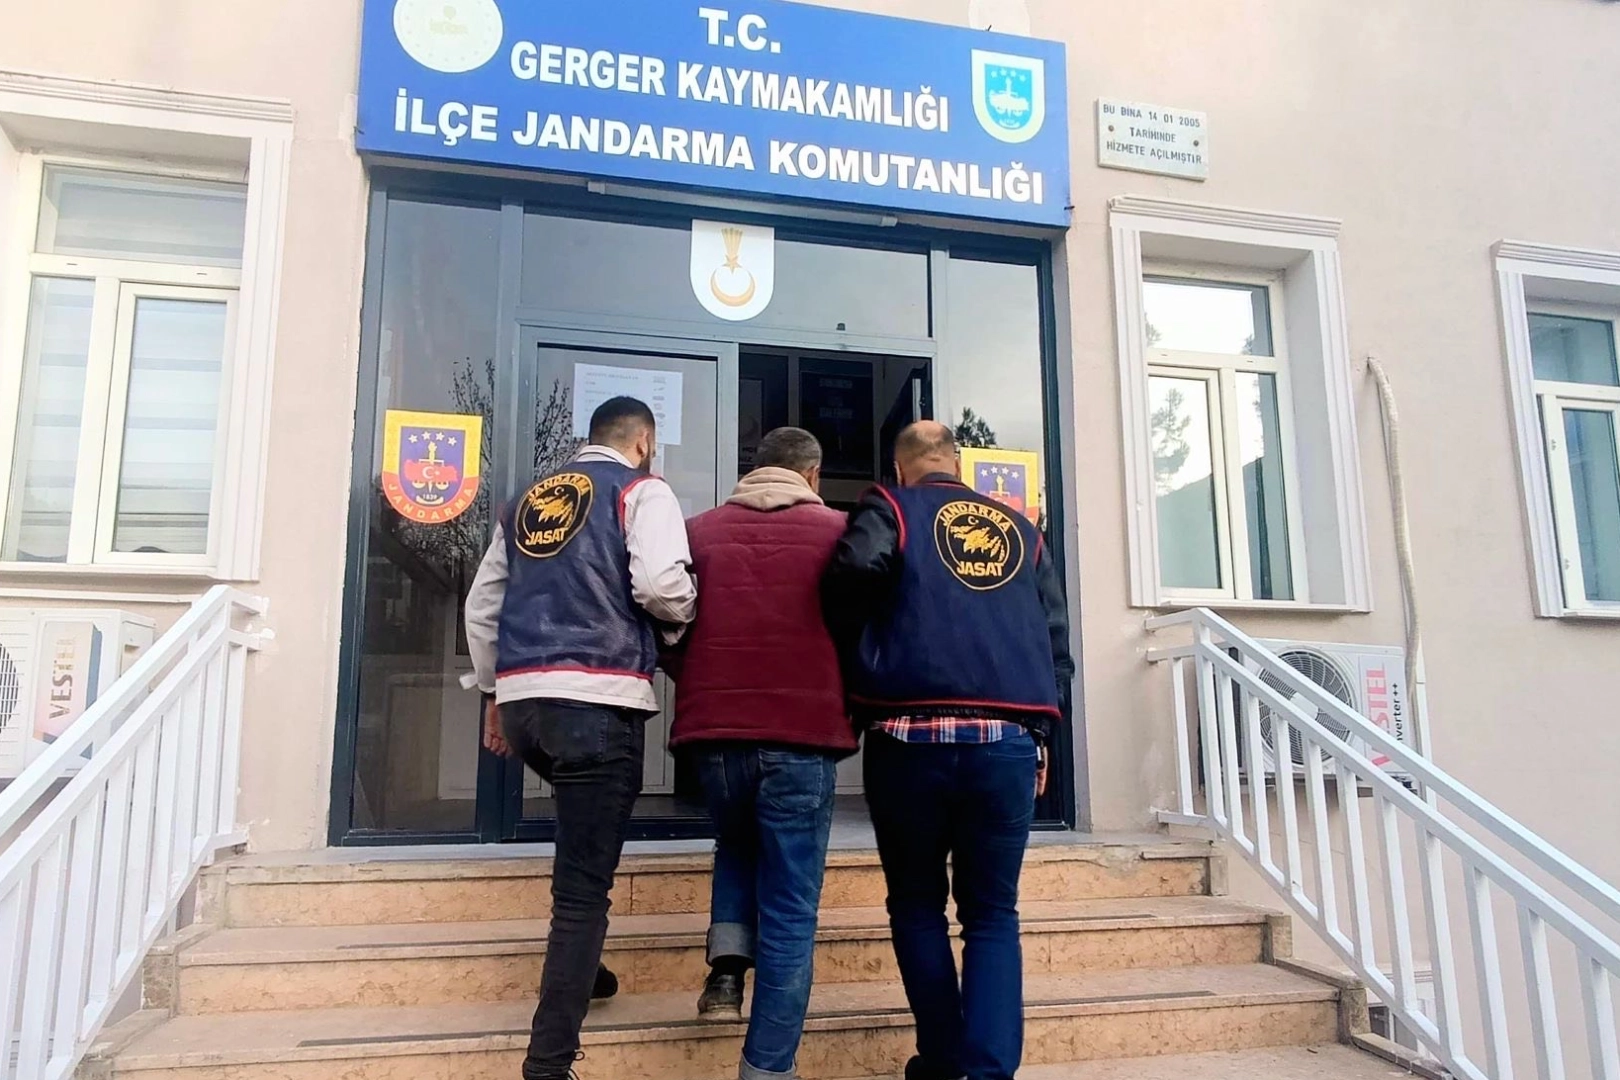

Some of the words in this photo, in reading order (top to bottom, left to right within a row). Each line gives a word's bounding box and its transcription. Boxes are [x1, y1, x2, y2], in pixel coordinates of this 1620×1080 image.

[699, 7, 782, 53] T.C.
[510, 41, 666, 96] GERGER
[677, 62, 949, 133] KAYMAKAMLIĞI
[1103, 104, 1115, 114] BU
[1121, 106, 1142, 118] BİNA
[1149, 111, 1157, 121] 14
[1163, 114, 1173, 123] 01
[1179, 116, 1200, 128] 2005
[394, 88, 499, 146] İLÇE
[511, 111, 755, 171] JANDARMA
[769, 140, 1043, 204] KOMUTANLIĞI
[1106, 140, 1145, 155] HİZMETE
[388, 483, 473, 520] JANDARMA
[940, 504, 1012, 532] JANDARMA
[525, 527, 569, 545] JASAT
[957, 561, 1004, 577] JASAT
